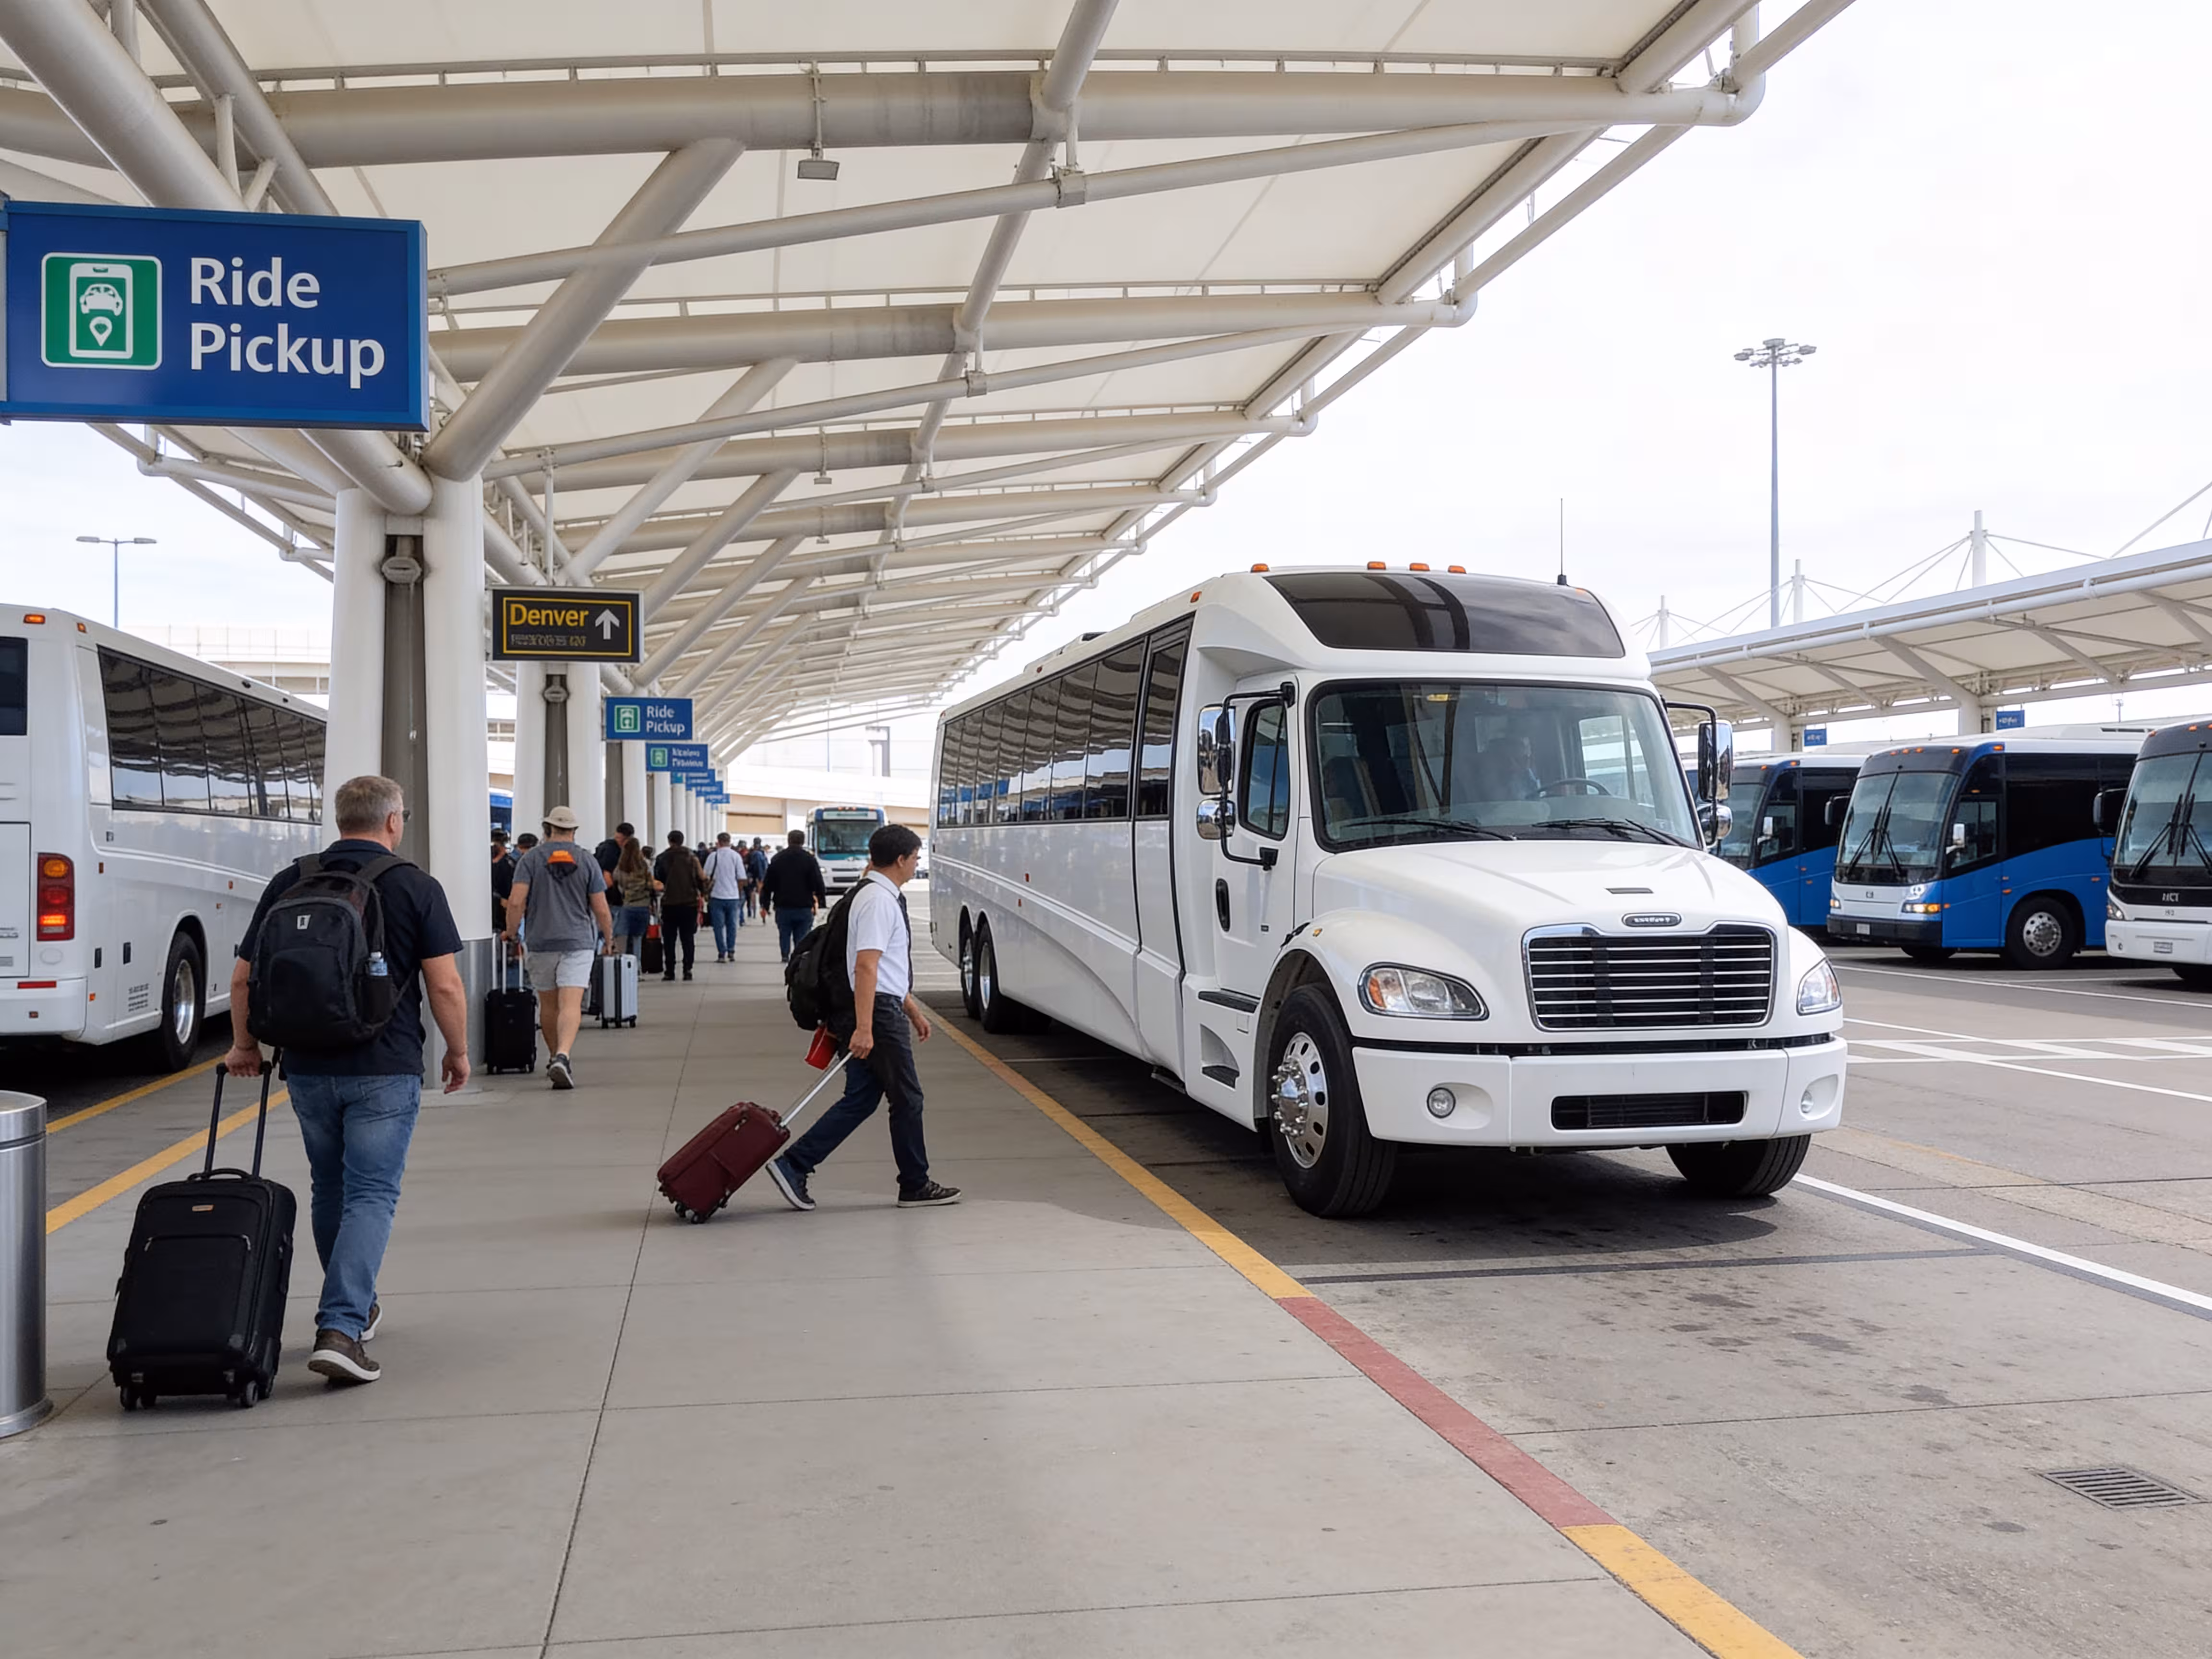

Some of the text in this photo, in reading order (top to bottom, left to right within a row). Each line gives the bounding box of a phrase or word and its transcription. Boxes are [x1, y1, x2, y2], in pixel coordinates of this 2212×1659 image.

[191, 257, 320, 308] Ride
[191, 323, 385, 389] Pickup
[510, 603, 589, 626] Denver
[647, 705, 675, 718] Ride
[646, 721, 685, 736] Pickup
